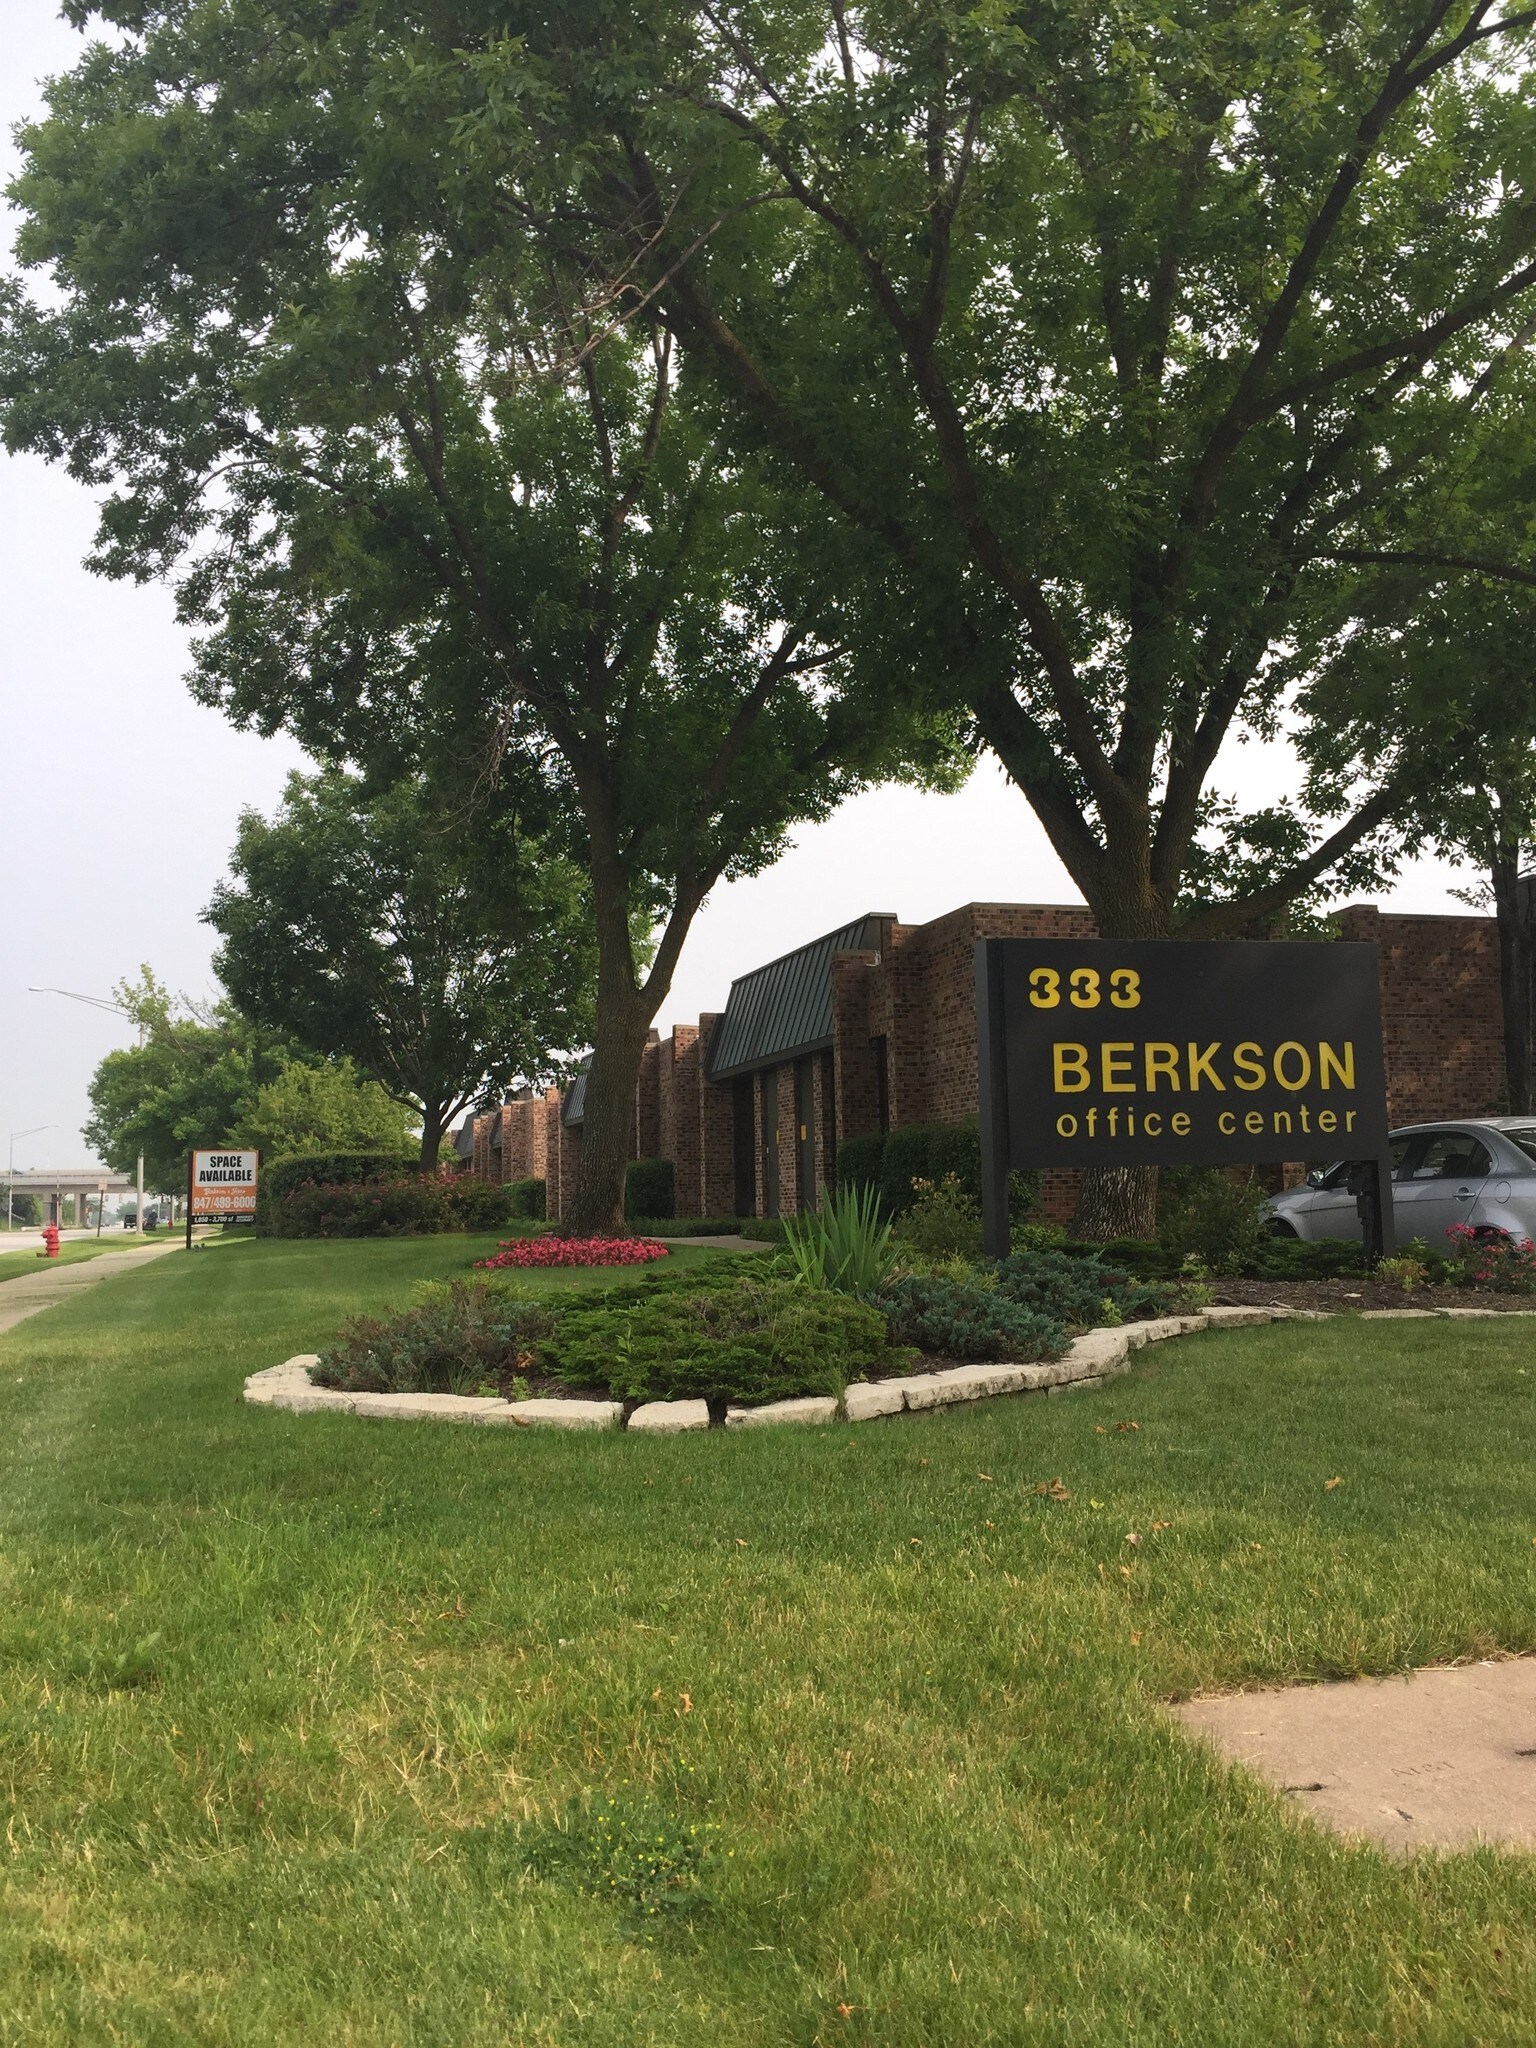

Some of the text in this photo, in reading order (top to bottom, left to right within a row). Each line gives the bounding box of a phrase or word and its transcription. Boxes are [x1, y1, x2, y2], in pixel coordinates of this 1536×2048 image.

[1028, 966, 1142, 1010] 333
[1052, 1040, 1357, 1094] BERKSON
[1056, 1103, 1357, 1138] office center
[199, 1169, 252, 1182] AVAILABLE
[210, 1155, 242, 1168] SPACE
